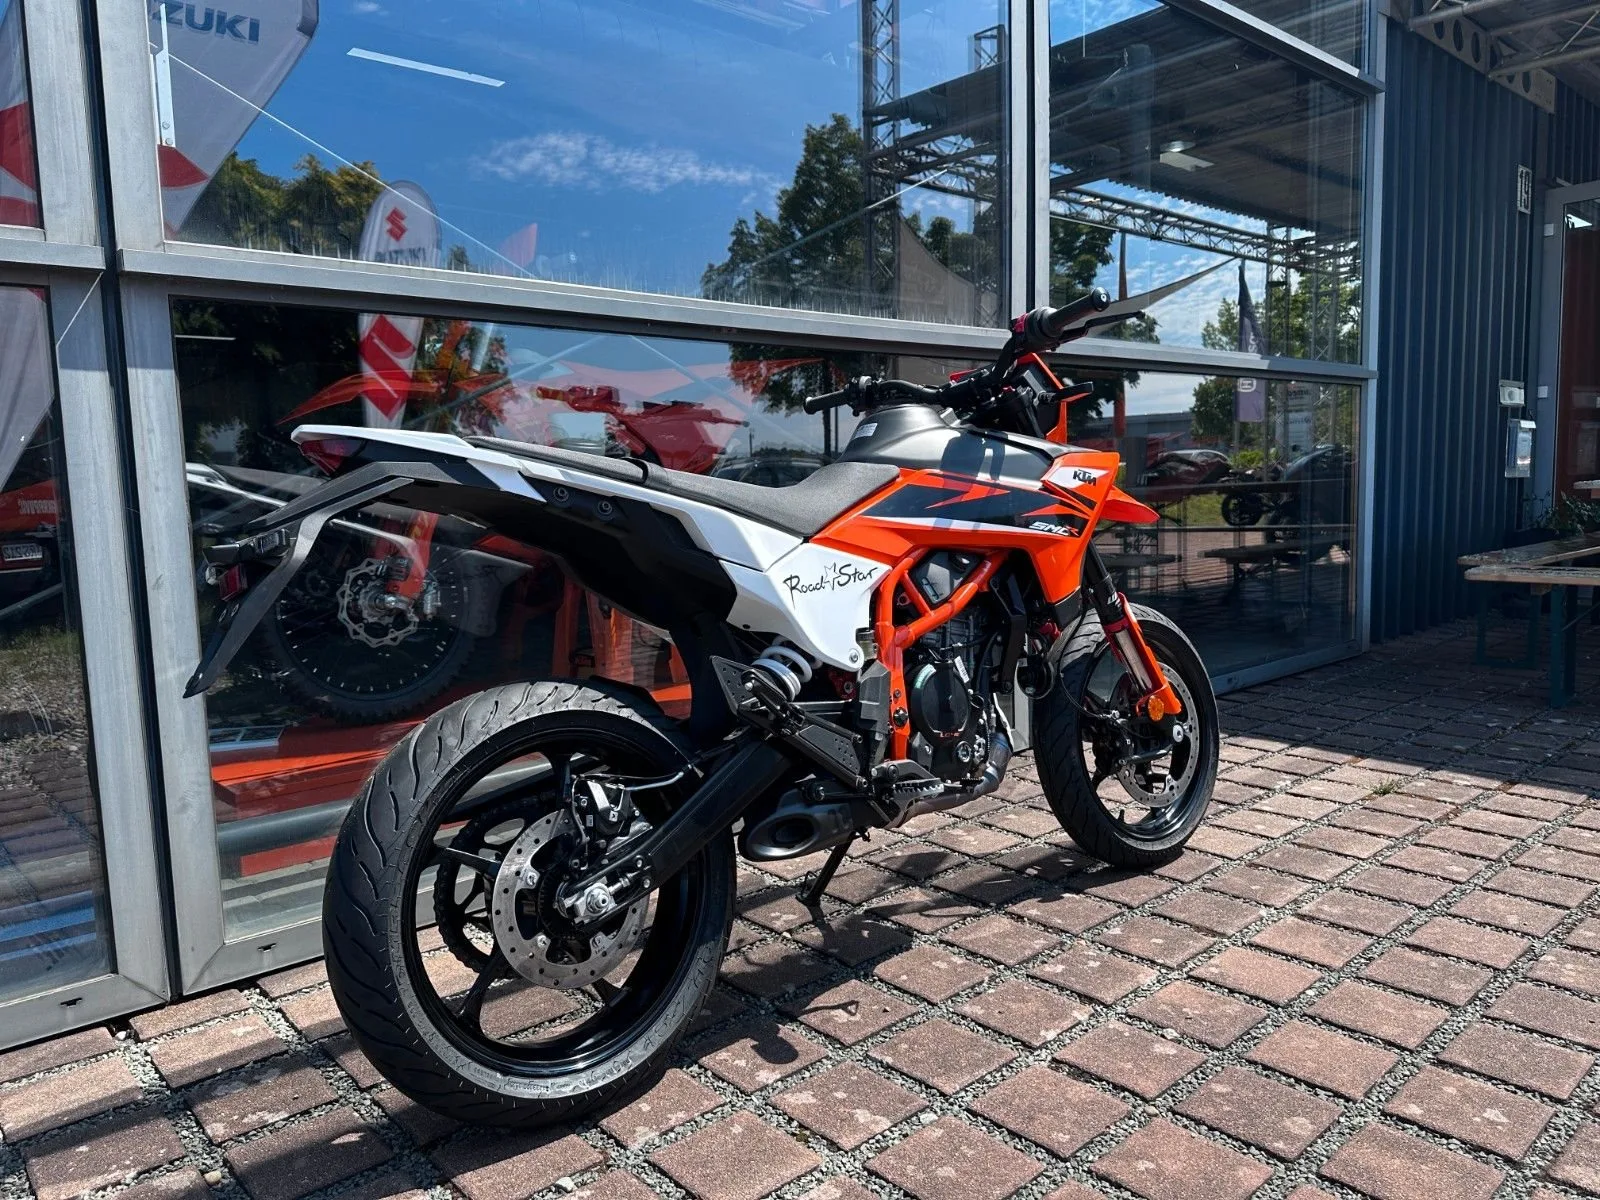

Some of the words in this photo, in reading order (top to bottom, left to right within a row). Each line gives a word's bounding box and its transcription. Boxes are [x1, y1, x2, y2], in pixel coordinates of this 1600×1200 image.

[1519, 169, 1530, 209] 19
[1072, 469, 1097, 487] KTM
[782, 574, 825, 609] Road
[837, 563, 878, 587] Star
